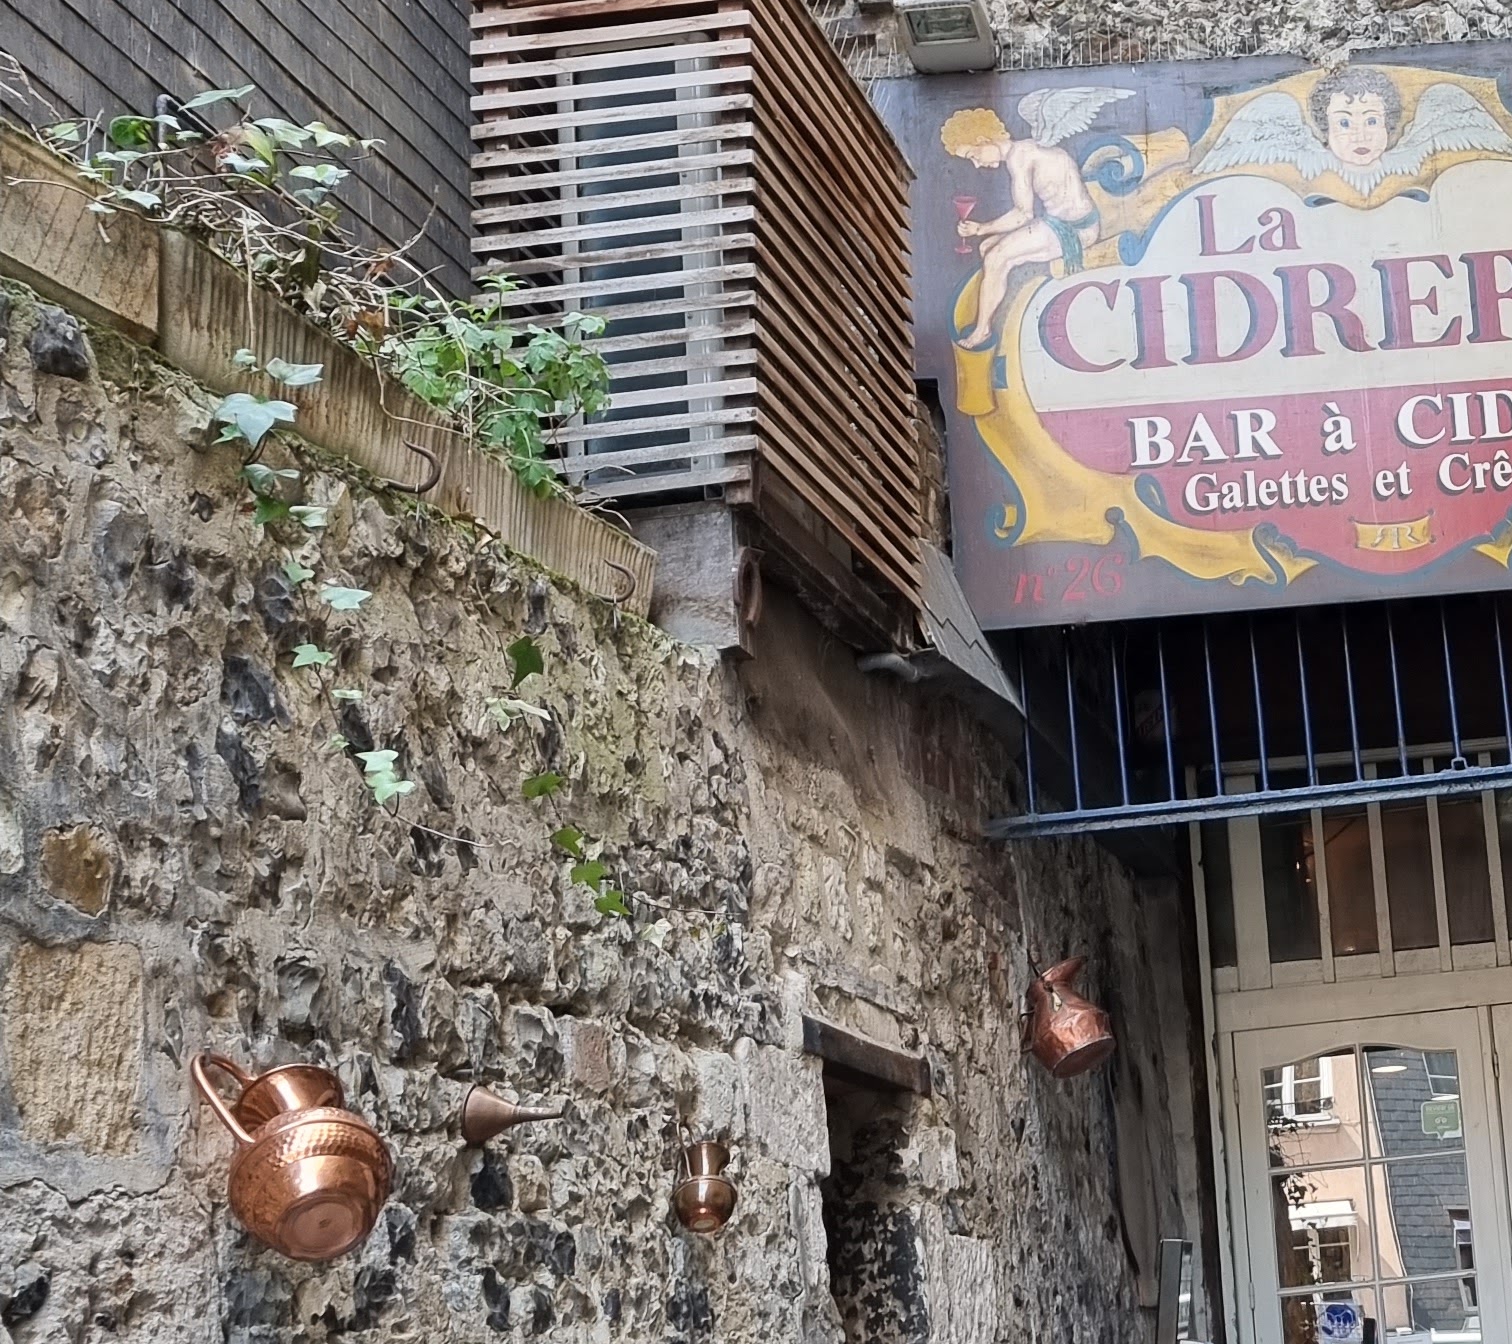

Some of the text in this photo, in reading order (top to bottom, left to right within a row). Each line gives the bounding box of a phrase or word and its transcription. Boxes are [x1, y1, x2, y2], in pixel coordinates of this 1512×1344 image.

[1199, 194, 1300, 258] La
[1128, 410, 1282, 470] BAR
[1323, 403, 1357, 454] à
[1184, 465, 1350, 515] Galettes
[1374, 459, 1413, 499] et
